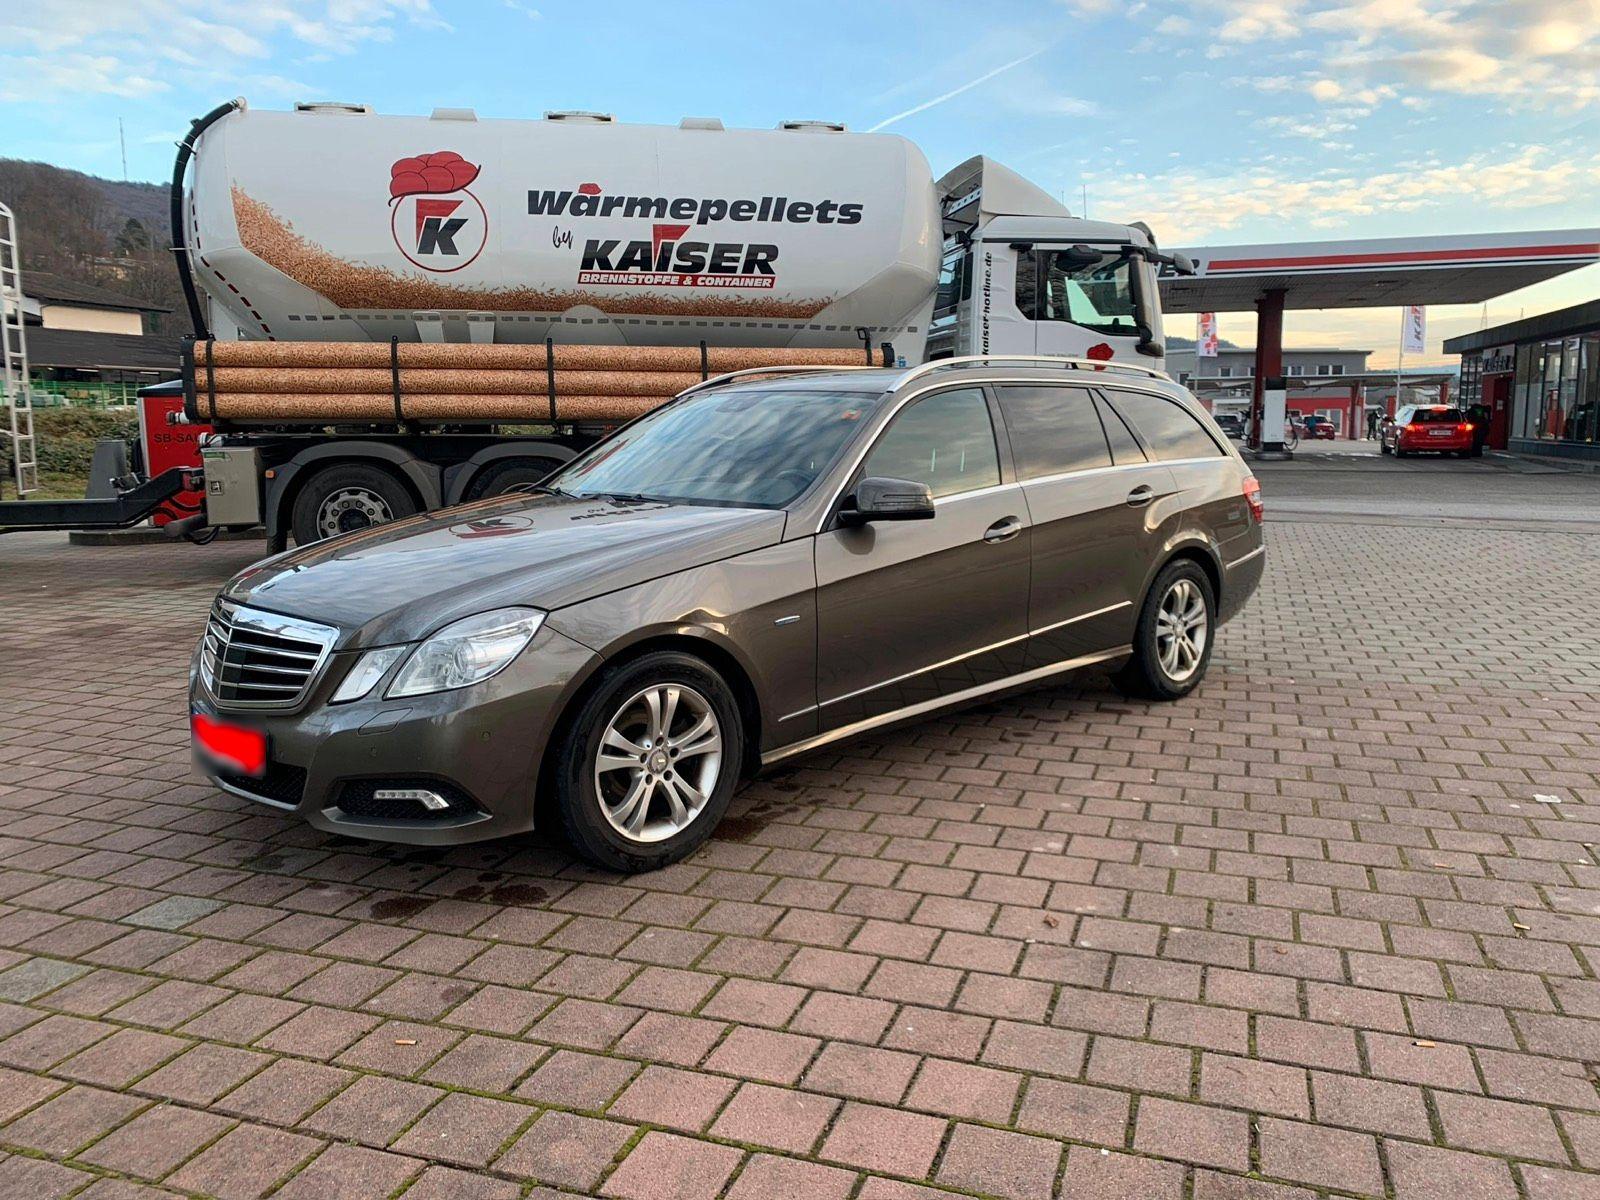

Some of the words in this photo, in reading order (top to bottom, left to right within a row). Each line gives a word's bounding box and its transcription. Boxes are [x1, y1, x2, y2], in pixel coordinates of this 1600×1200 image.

[528, 184, 864, 225] Wärmepellets
[552, 225, 574, 250] by
[580, 238, 779, 275] KAISER
[579, 273, 681, 286] BRENNSTOFFE
[683, 275, 694, 286] &
[697, 276, 773, 288] CONTAINER
[981, 251, 993, 367] kaiser-hotline.de
